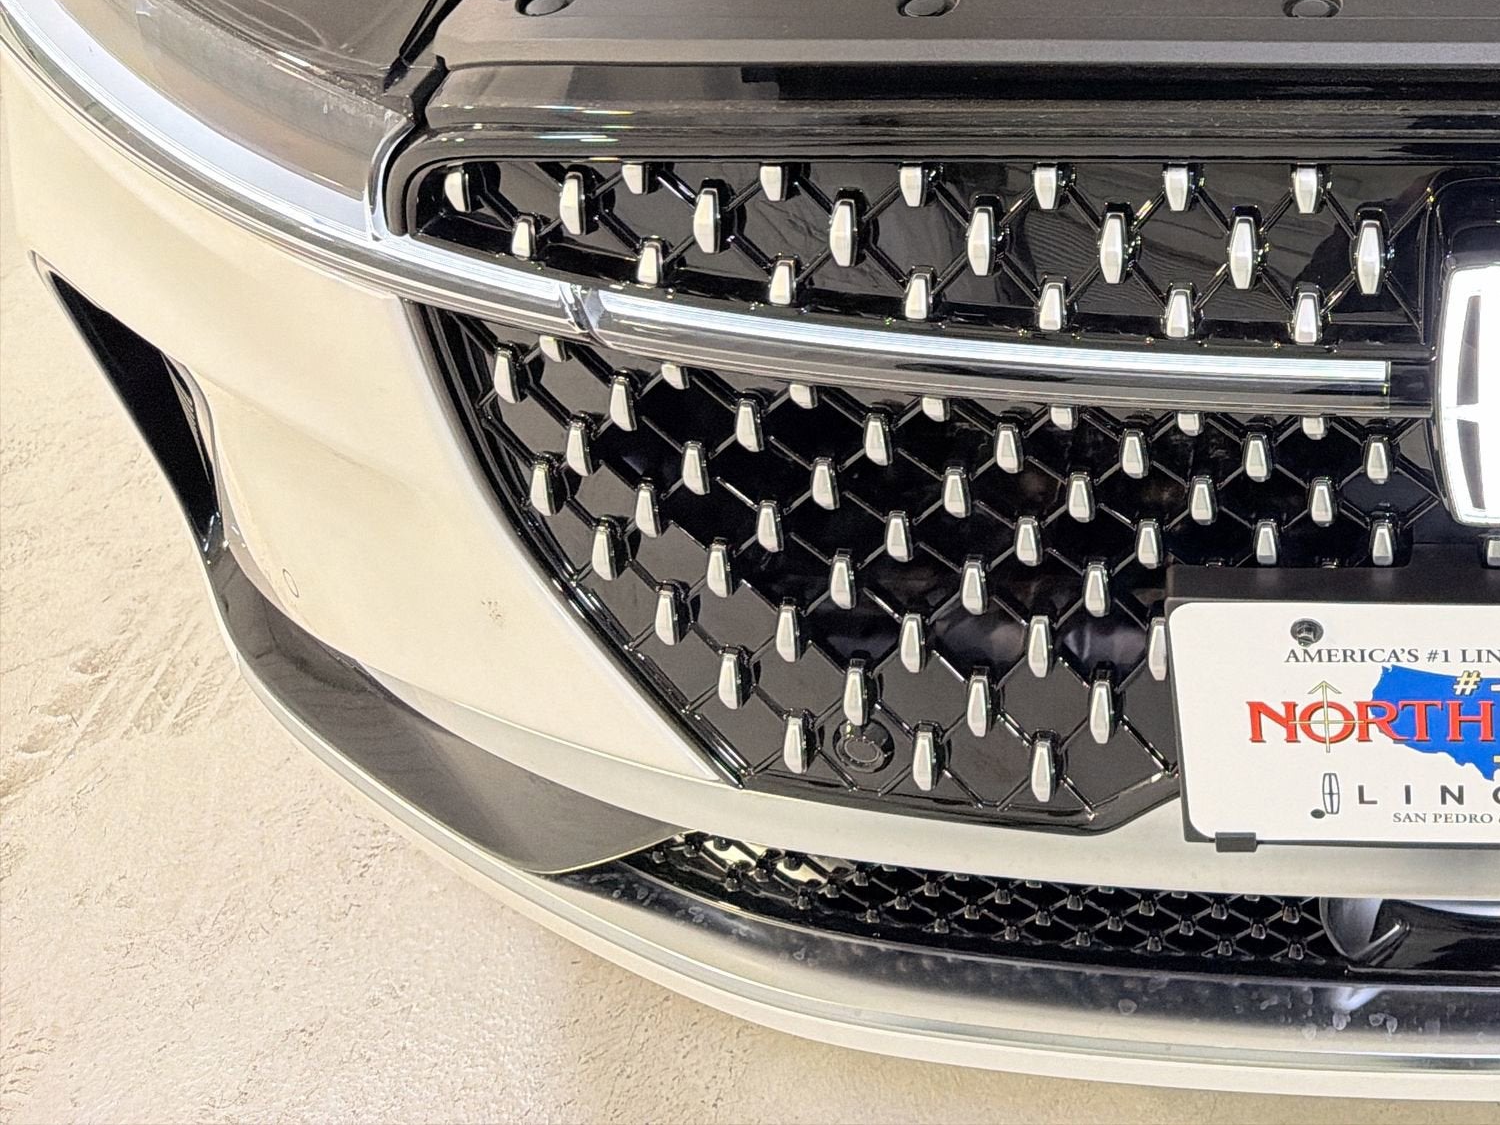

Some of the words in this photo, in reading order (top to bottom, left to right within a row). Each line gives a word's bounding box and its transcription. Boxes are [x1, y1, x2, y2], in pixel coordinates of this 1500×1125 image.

[1284, 648, 1420, 663] AMERICA'S
[1426, 649, 1451, 663] #1
[1245, 700, 1496, 744] NORTH
[1392, 812, 1427, 824] SAN
[1433, 812, 1493, 824] PEDRO
